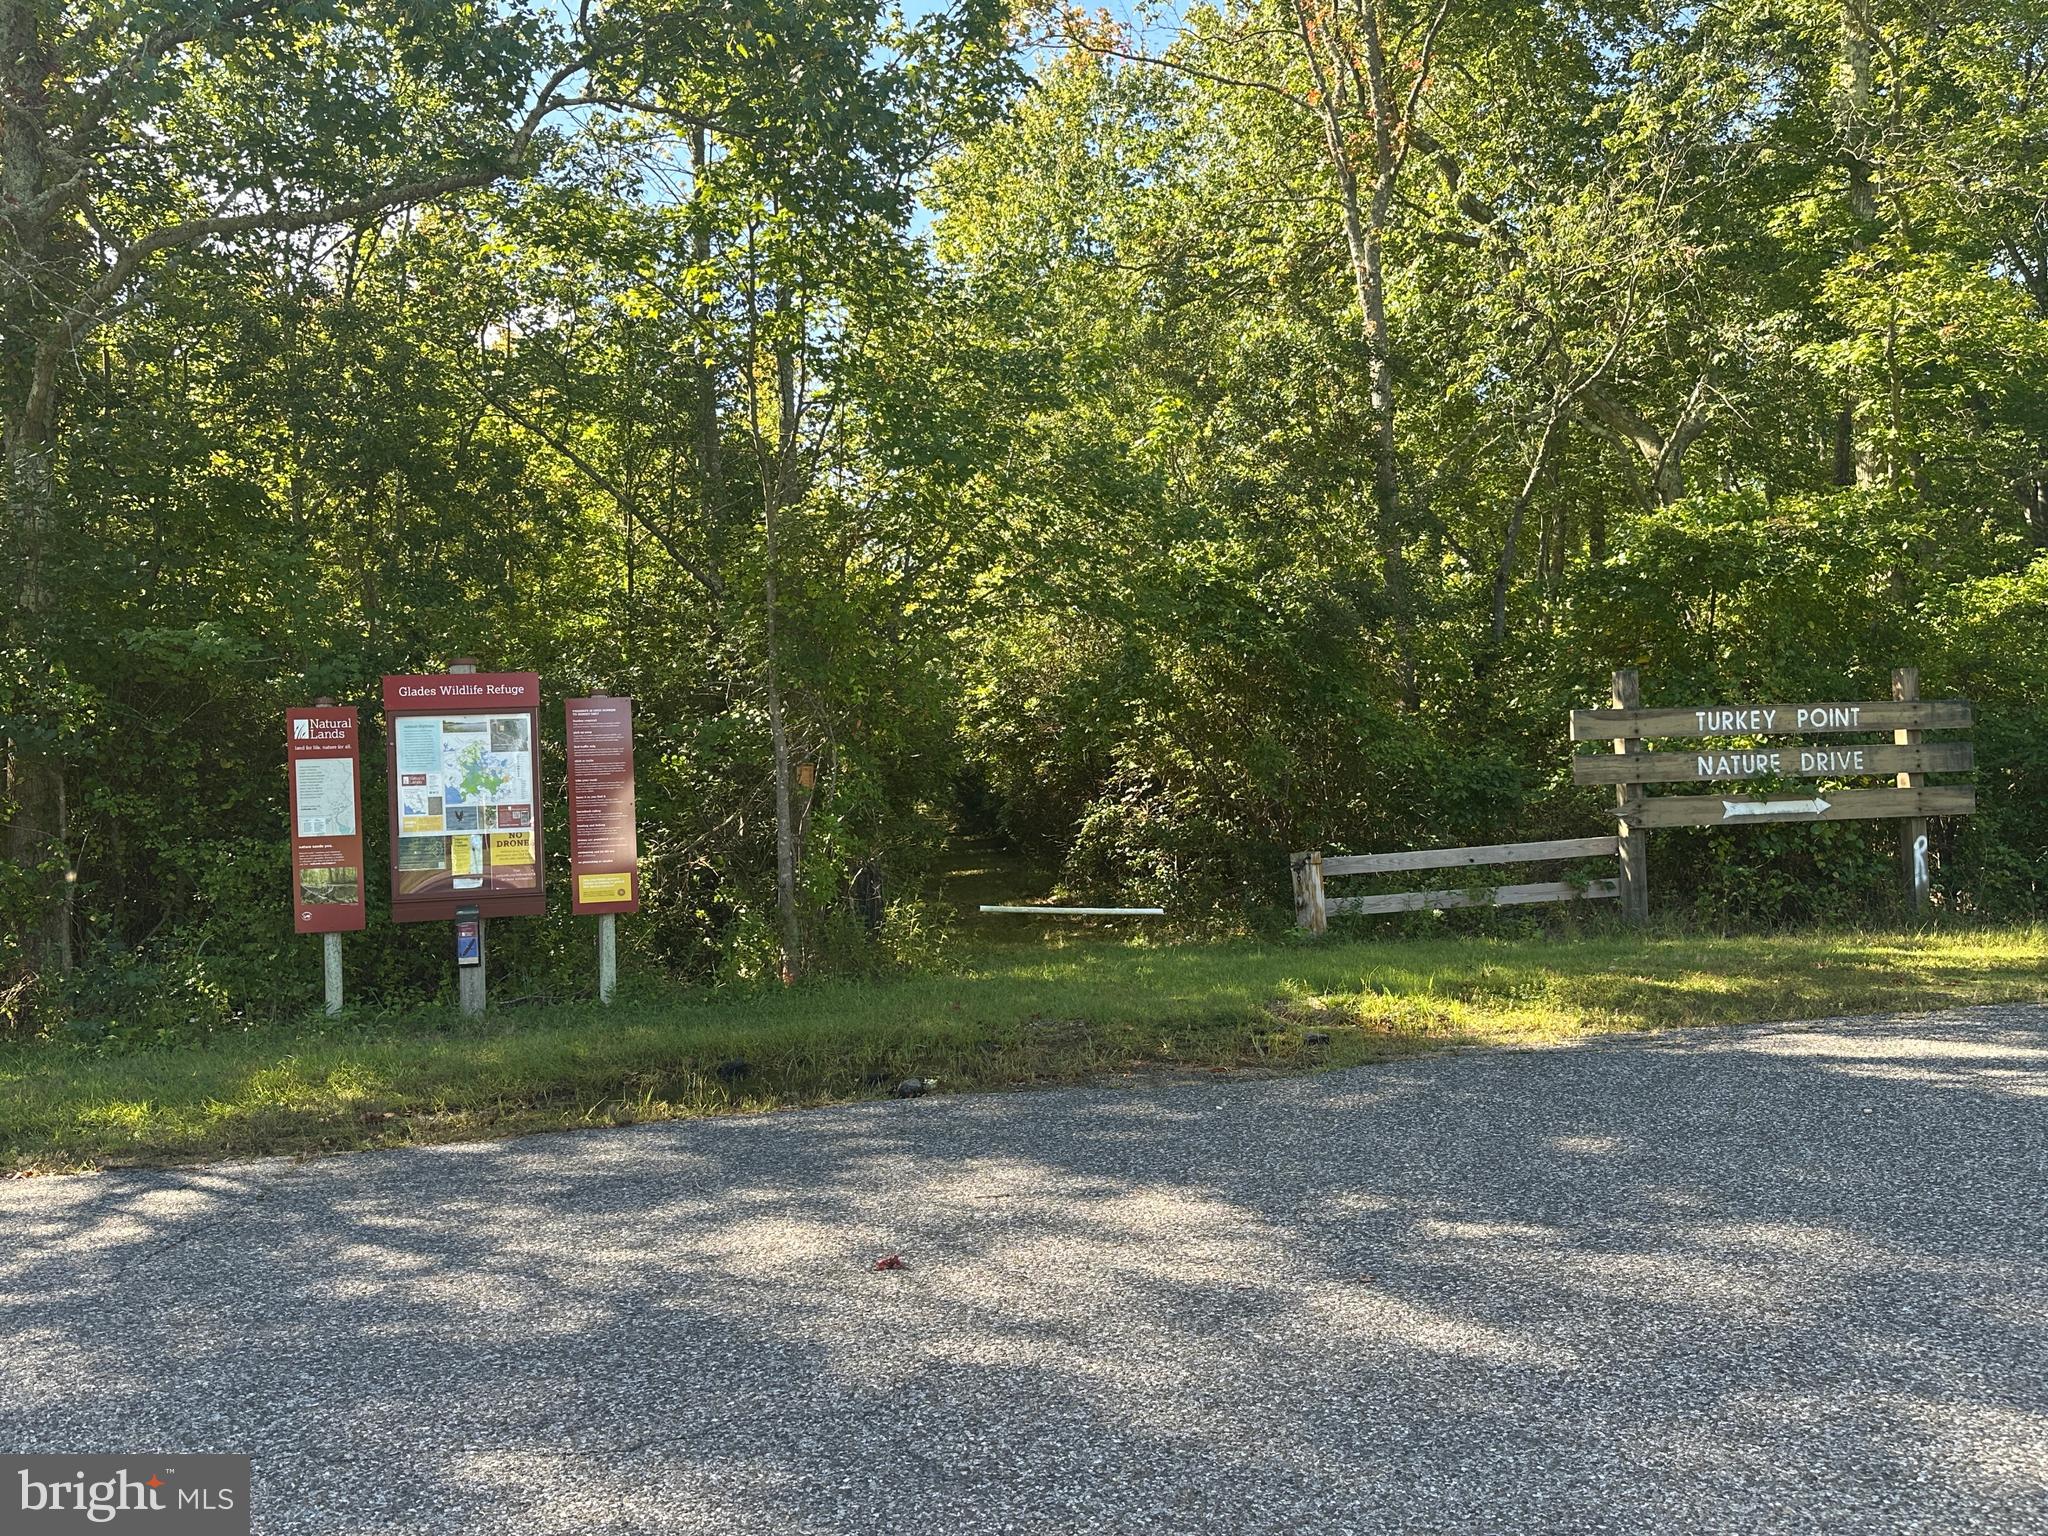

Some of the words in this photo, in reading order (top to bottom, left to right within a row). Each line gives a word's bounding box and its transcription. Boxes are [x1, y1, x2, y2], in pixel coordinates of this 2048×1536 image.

[399, 686, 436, 697] Glades
[440, 684, 483, 696] Wildlife
[487, 684, 525, 696] Refuge
[310, 718, 352, 729] Natural
[1696, 710, 1776, 731] TURKEY
[1797, 707, 1860, 728] POINT
[310, 729, 345, 740] Lands
[1697, 753, 1781, 776] NATURE
[1801, 751, 1863, 772] DRIVE
[497, 840, 535, 848] DRONE
